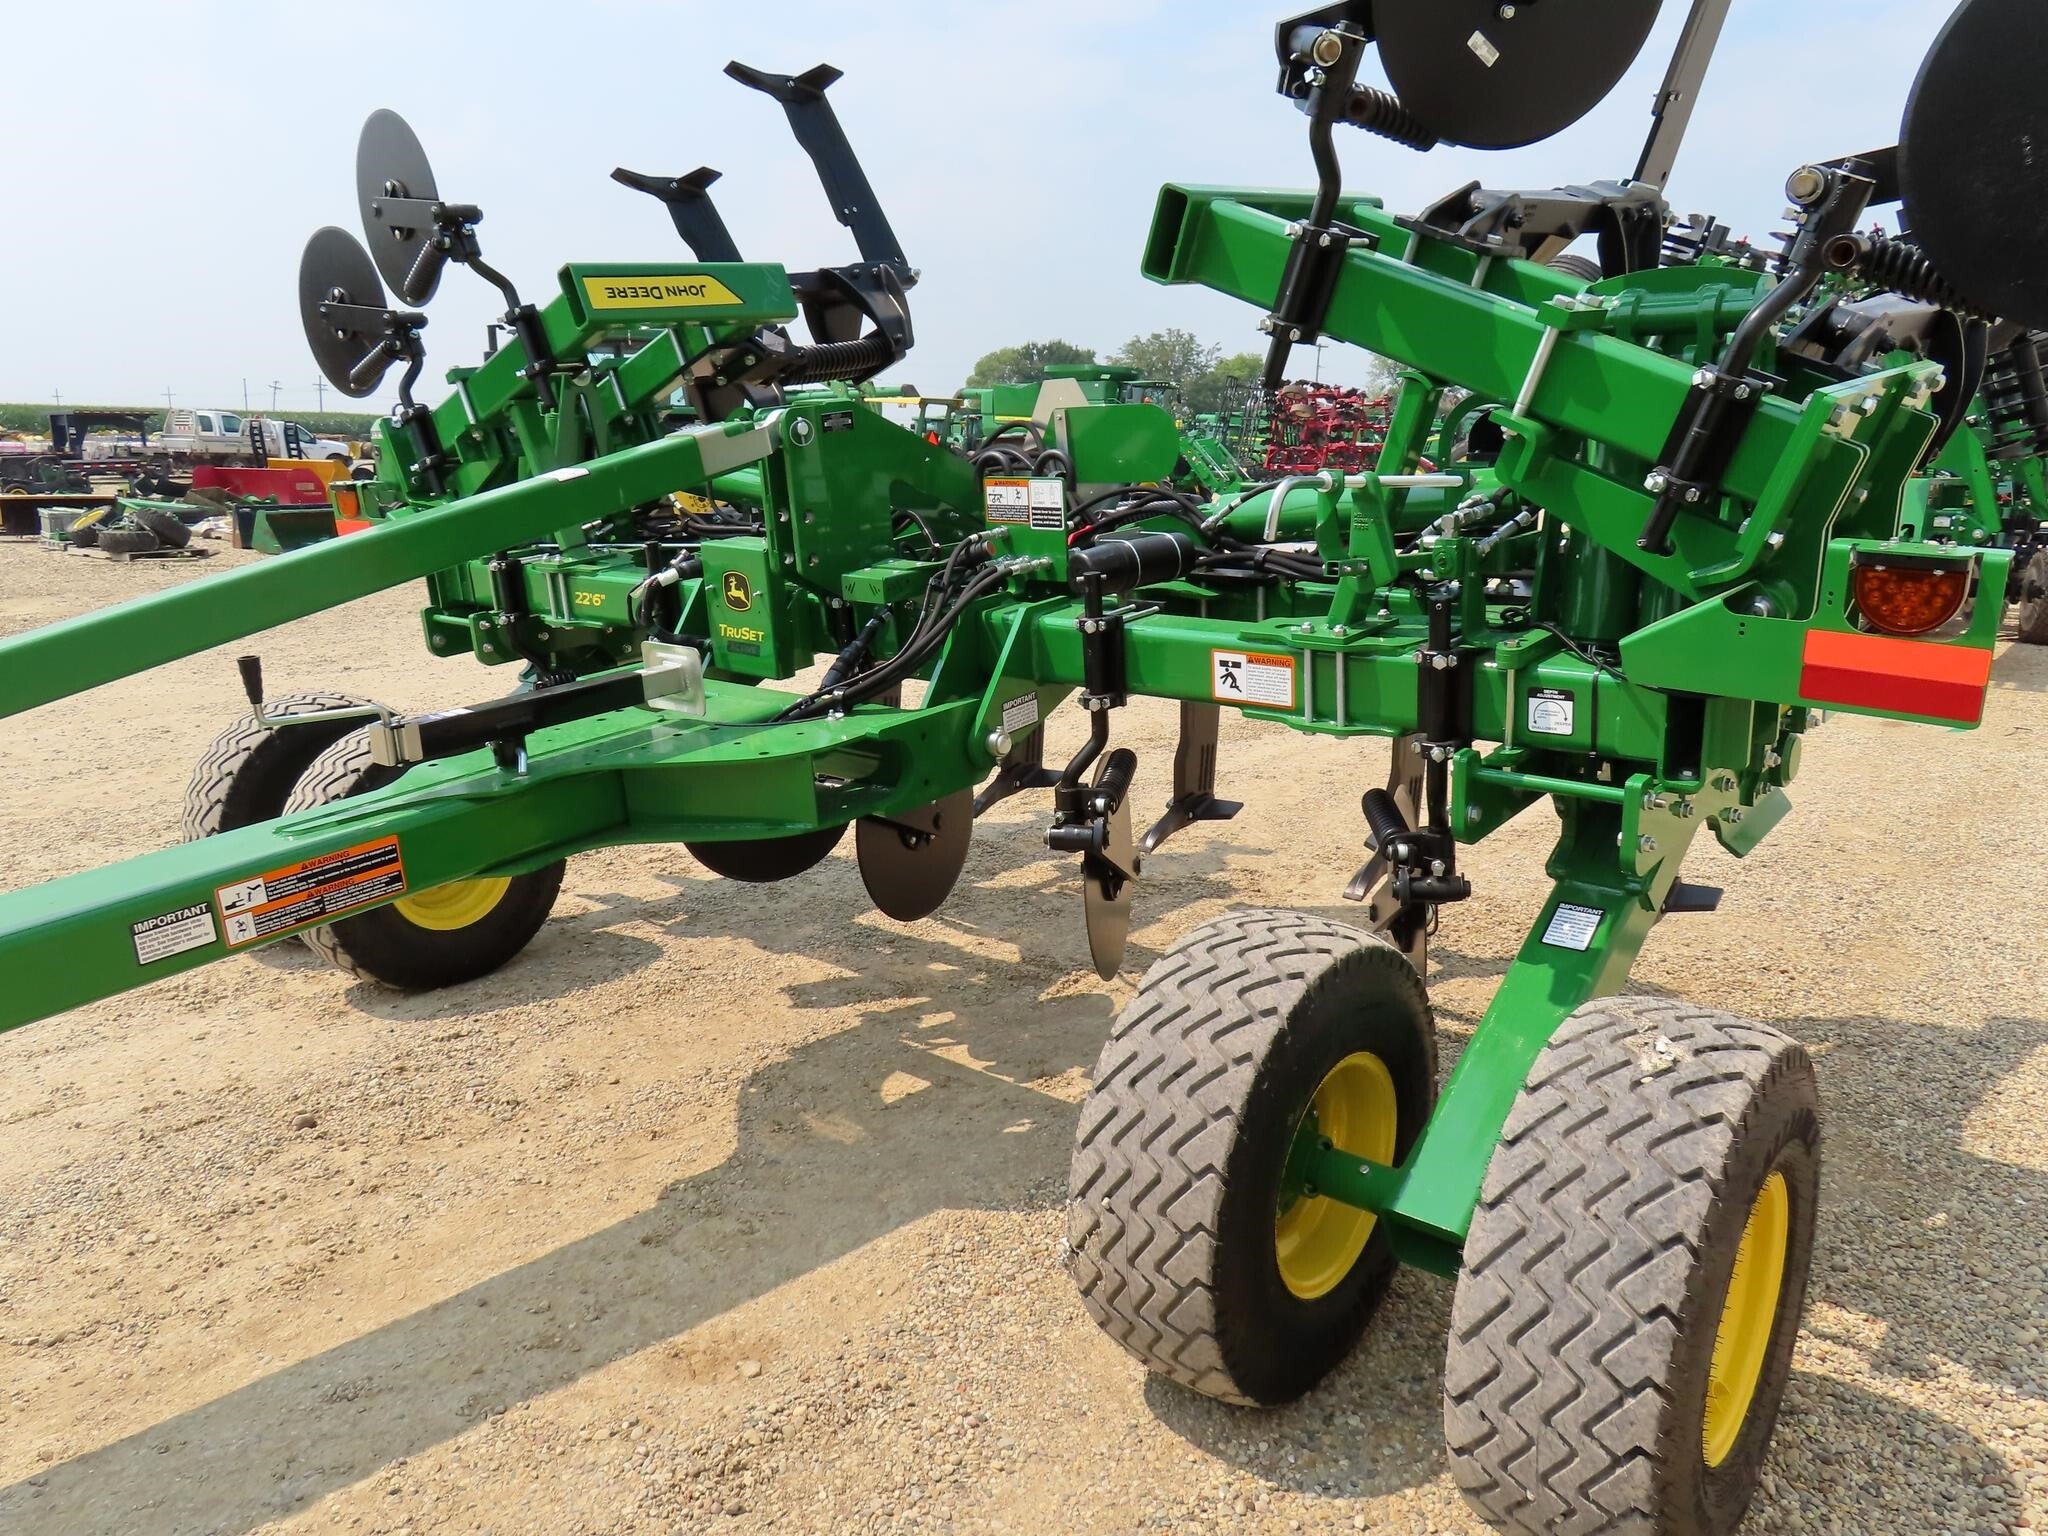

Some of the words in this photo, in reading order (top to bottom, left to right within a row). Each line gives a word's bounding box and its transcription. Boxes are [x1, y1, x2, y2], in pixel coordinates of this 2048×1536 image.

[604, 286, 664, 300] DEERE
[665, 284, 707, 298] JOHN
[575, 591, 606, 607] 22'6"
[1252, 655, 1291, 668] WARNING
[1002, 691, 1036, 711] IMPORTANT
[308, 850, 350, 869] WARNING
[313, 877, 355, 897] WARNING
[1558, 902, 1604, 915] IMPORTANT
[133, 902, 208, 934] IMPORTANT
